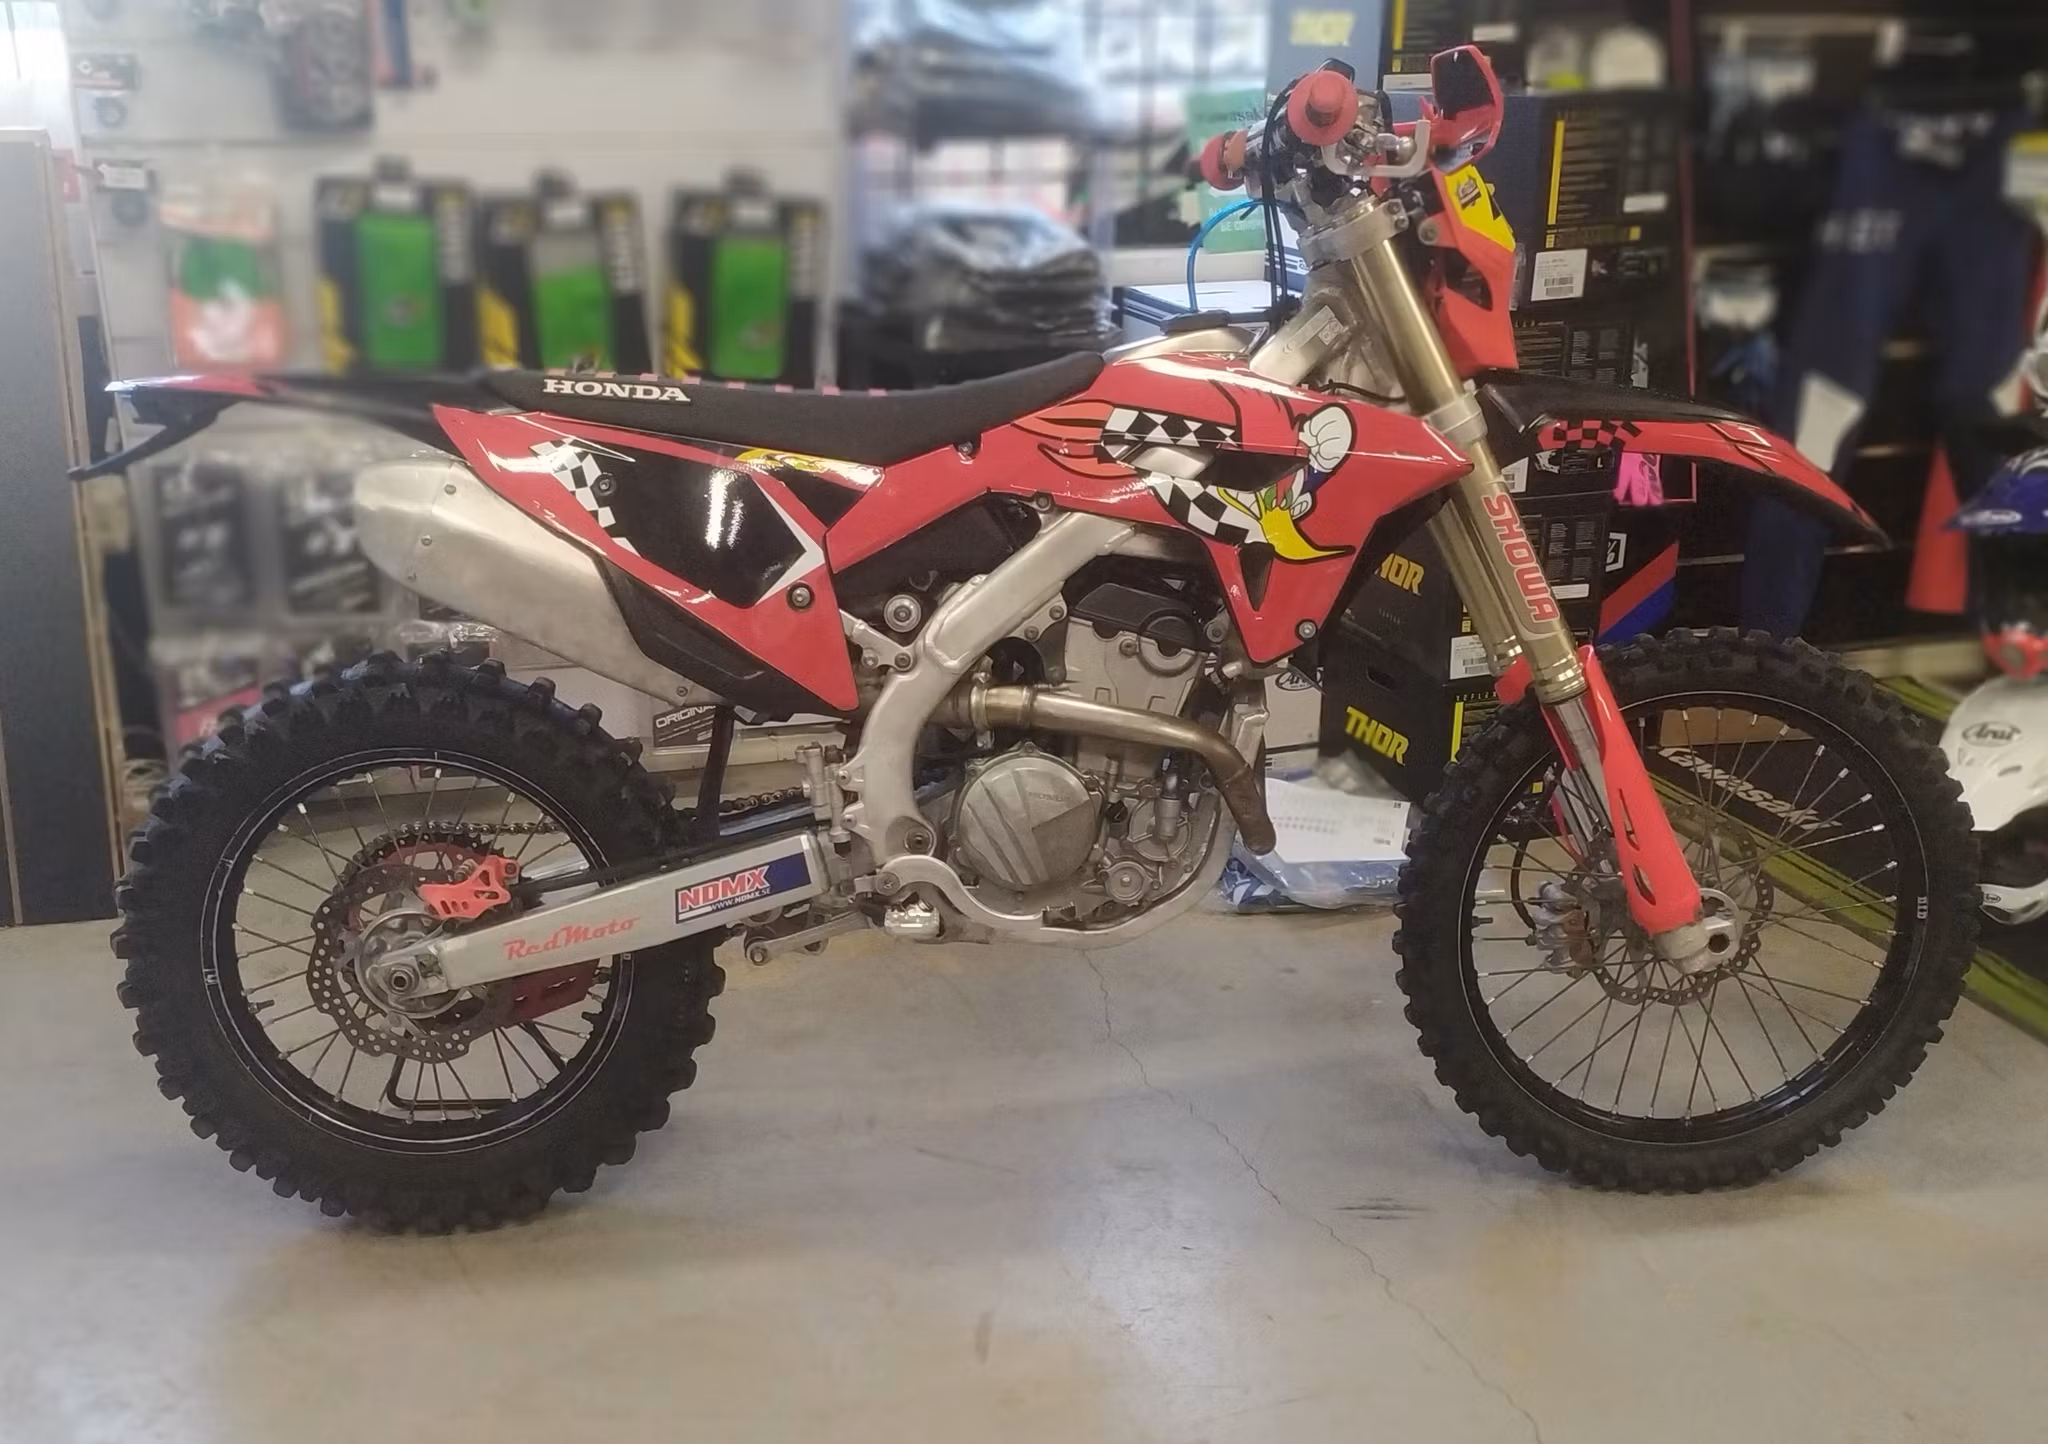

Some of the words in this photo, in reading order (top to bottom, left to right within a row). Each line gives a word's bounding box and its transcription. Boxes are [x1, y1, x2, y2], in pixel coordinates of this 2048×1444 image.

[543, 379, 691, 402] HONDA
[1378, 553, 1425, 596] OR
[1481, 492, 1560, 623] SHOWA
[1345, 706, 1409, 766] THOR
[678, 865, 771, 912] NDMX
[711, 887, 771, 911] WWW.NDMX.SE
[503, 917, 641, 960] RedMoto
